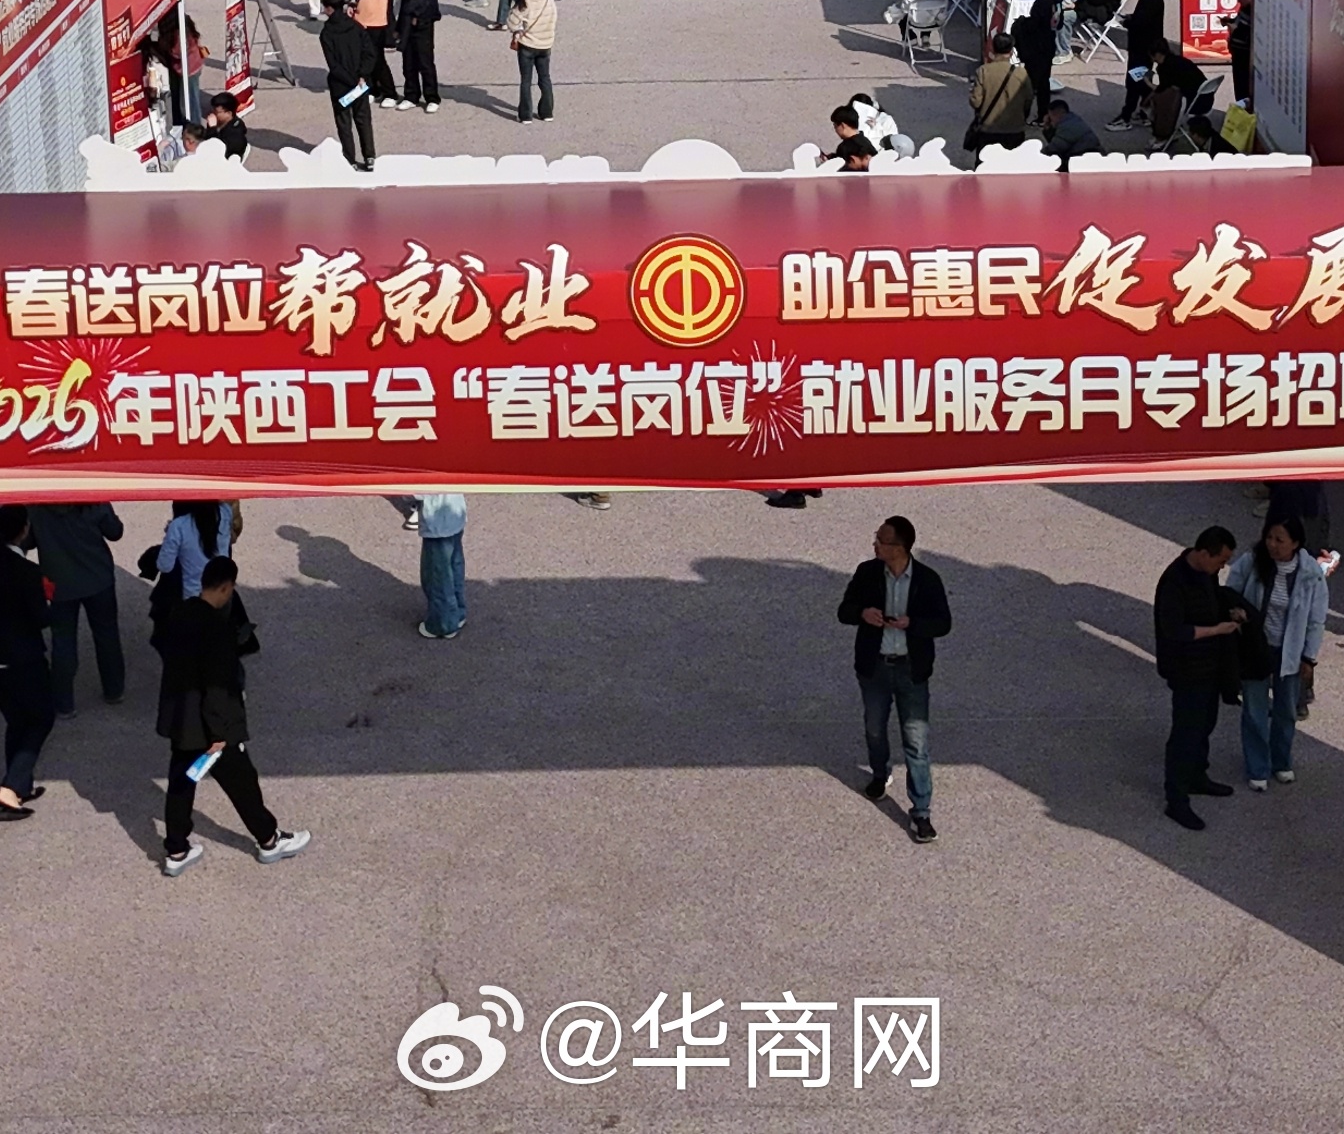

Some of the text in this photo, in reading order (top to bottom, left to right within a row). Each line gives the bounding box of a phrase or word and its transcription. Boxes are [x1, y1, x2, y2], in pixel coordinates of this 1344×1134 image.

[4, 240, 599, 356] 春送岗位帮就业
